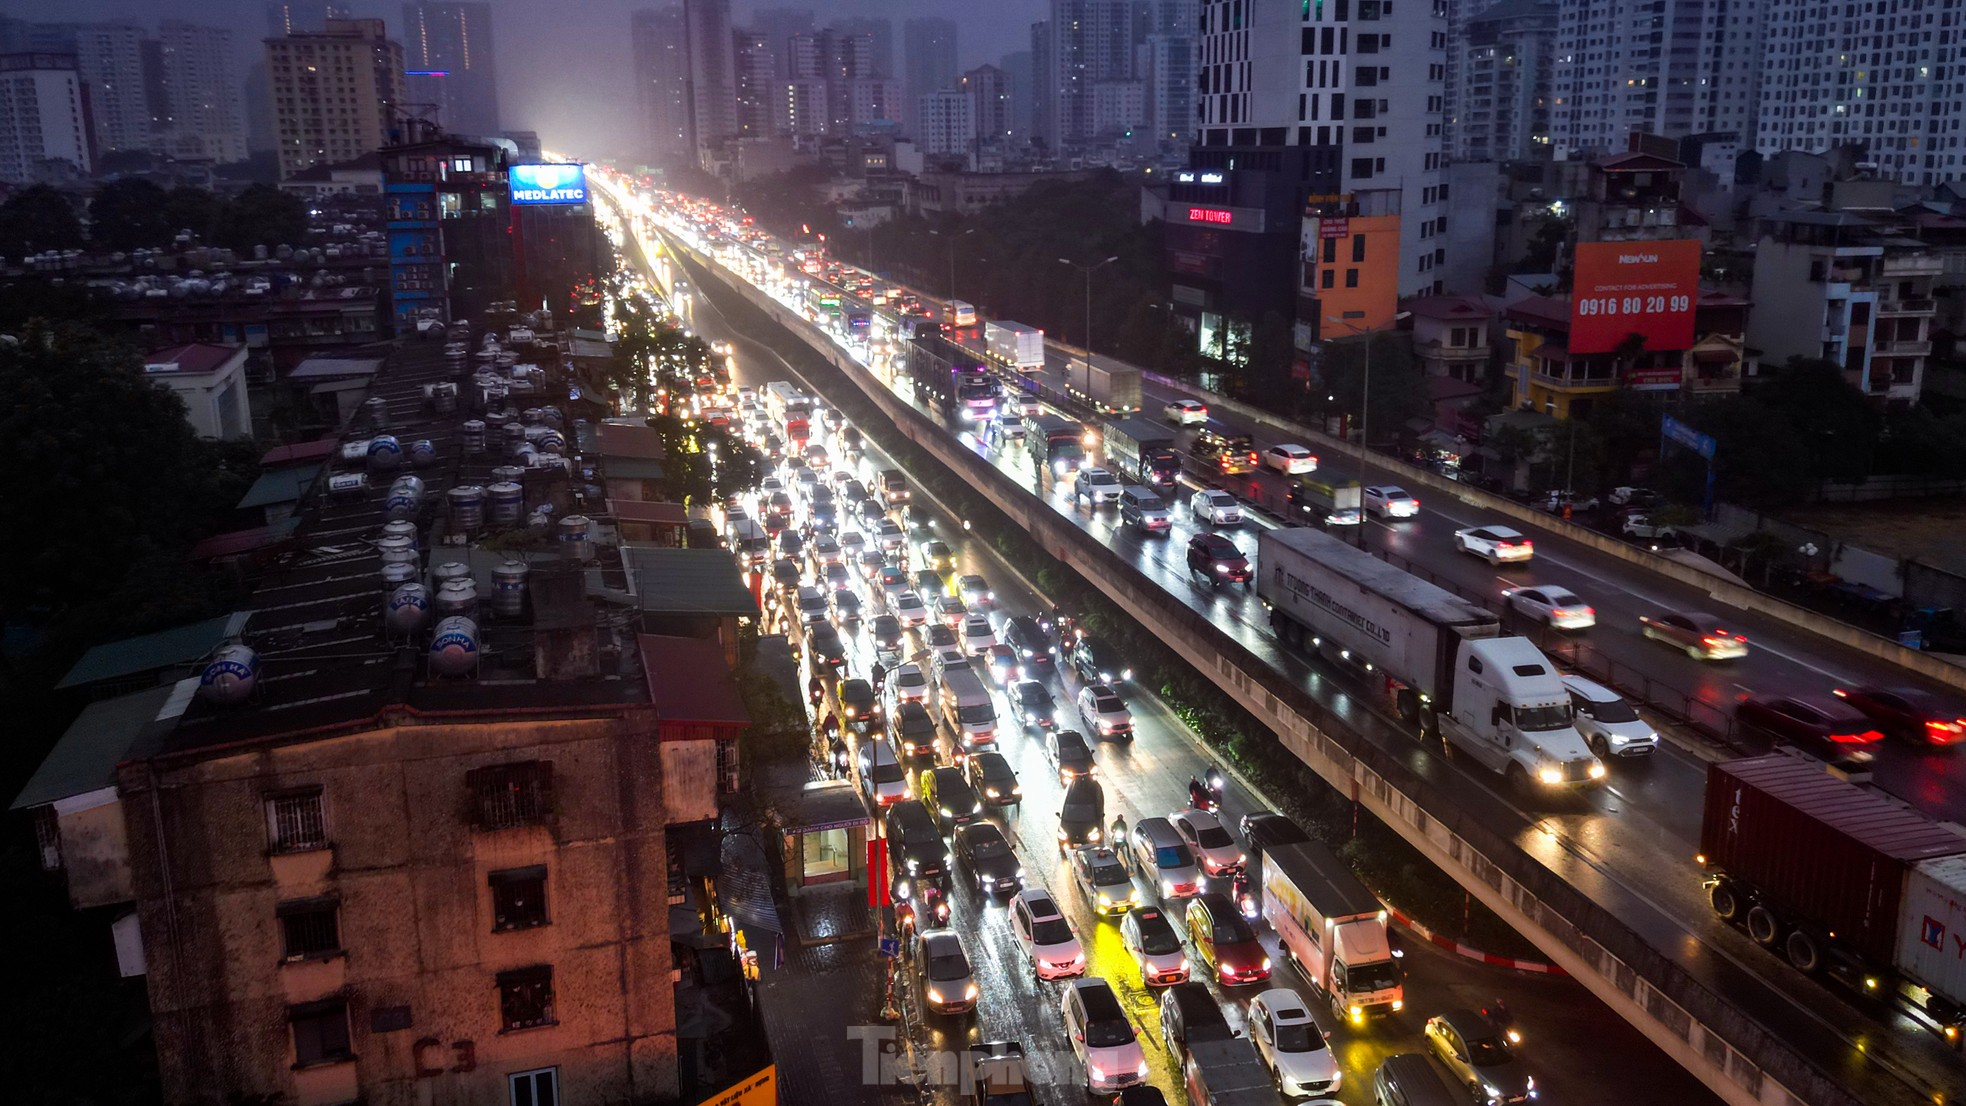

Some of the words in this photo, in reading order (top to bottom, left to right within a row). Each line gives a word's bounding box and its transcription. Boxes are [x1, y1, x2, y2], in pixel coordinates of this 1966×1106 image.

[513, 189, 583, 201] MEDLATEC
[1189, 209, 1204, 220] ZEN
[1205, 210, 1232, 224] TOWER
[1594, 284, 1623, 292] CONTACT
[1580, 298, 1617, 316] 0916
[1622, 297, 1641, 315] 80
[1646, 296, 1665, 313] 20
[1670, 295, 1689, 313] 99
[1332, 600, 1366, 628] CONTAINER
